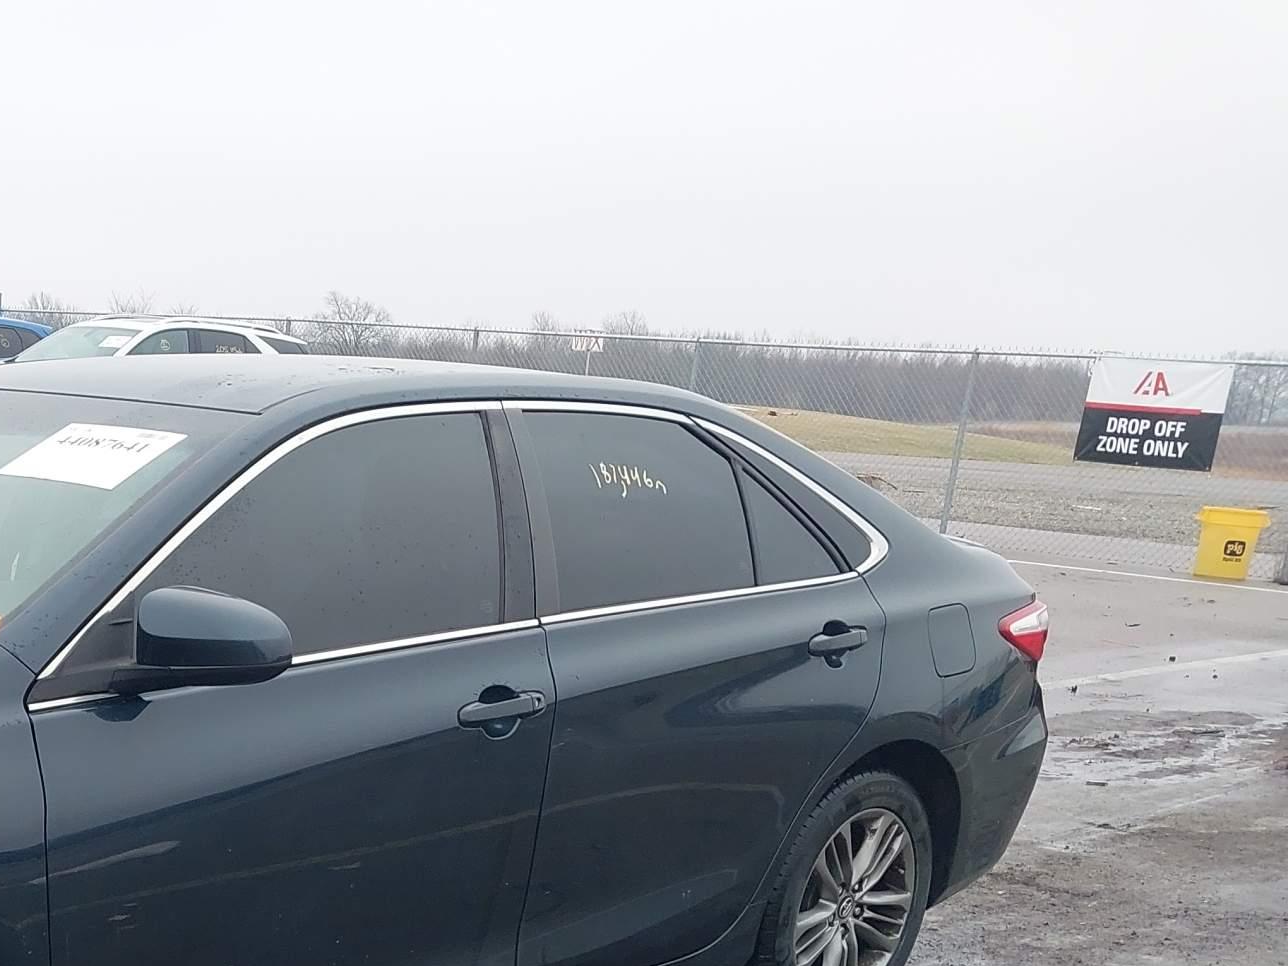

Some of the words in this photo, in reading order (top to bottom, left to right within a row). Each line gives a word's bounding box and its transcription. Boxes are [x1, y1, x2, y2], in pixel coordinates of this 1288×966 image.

[1106, 416, 1151, 436] DROP
[1154, 420, 1187, 438] OFF
[56, 435, 150, 453] 44087641
[1096, 435, 1139, 455] ZONE
[1142, 439, 1189, 458] ONLY
